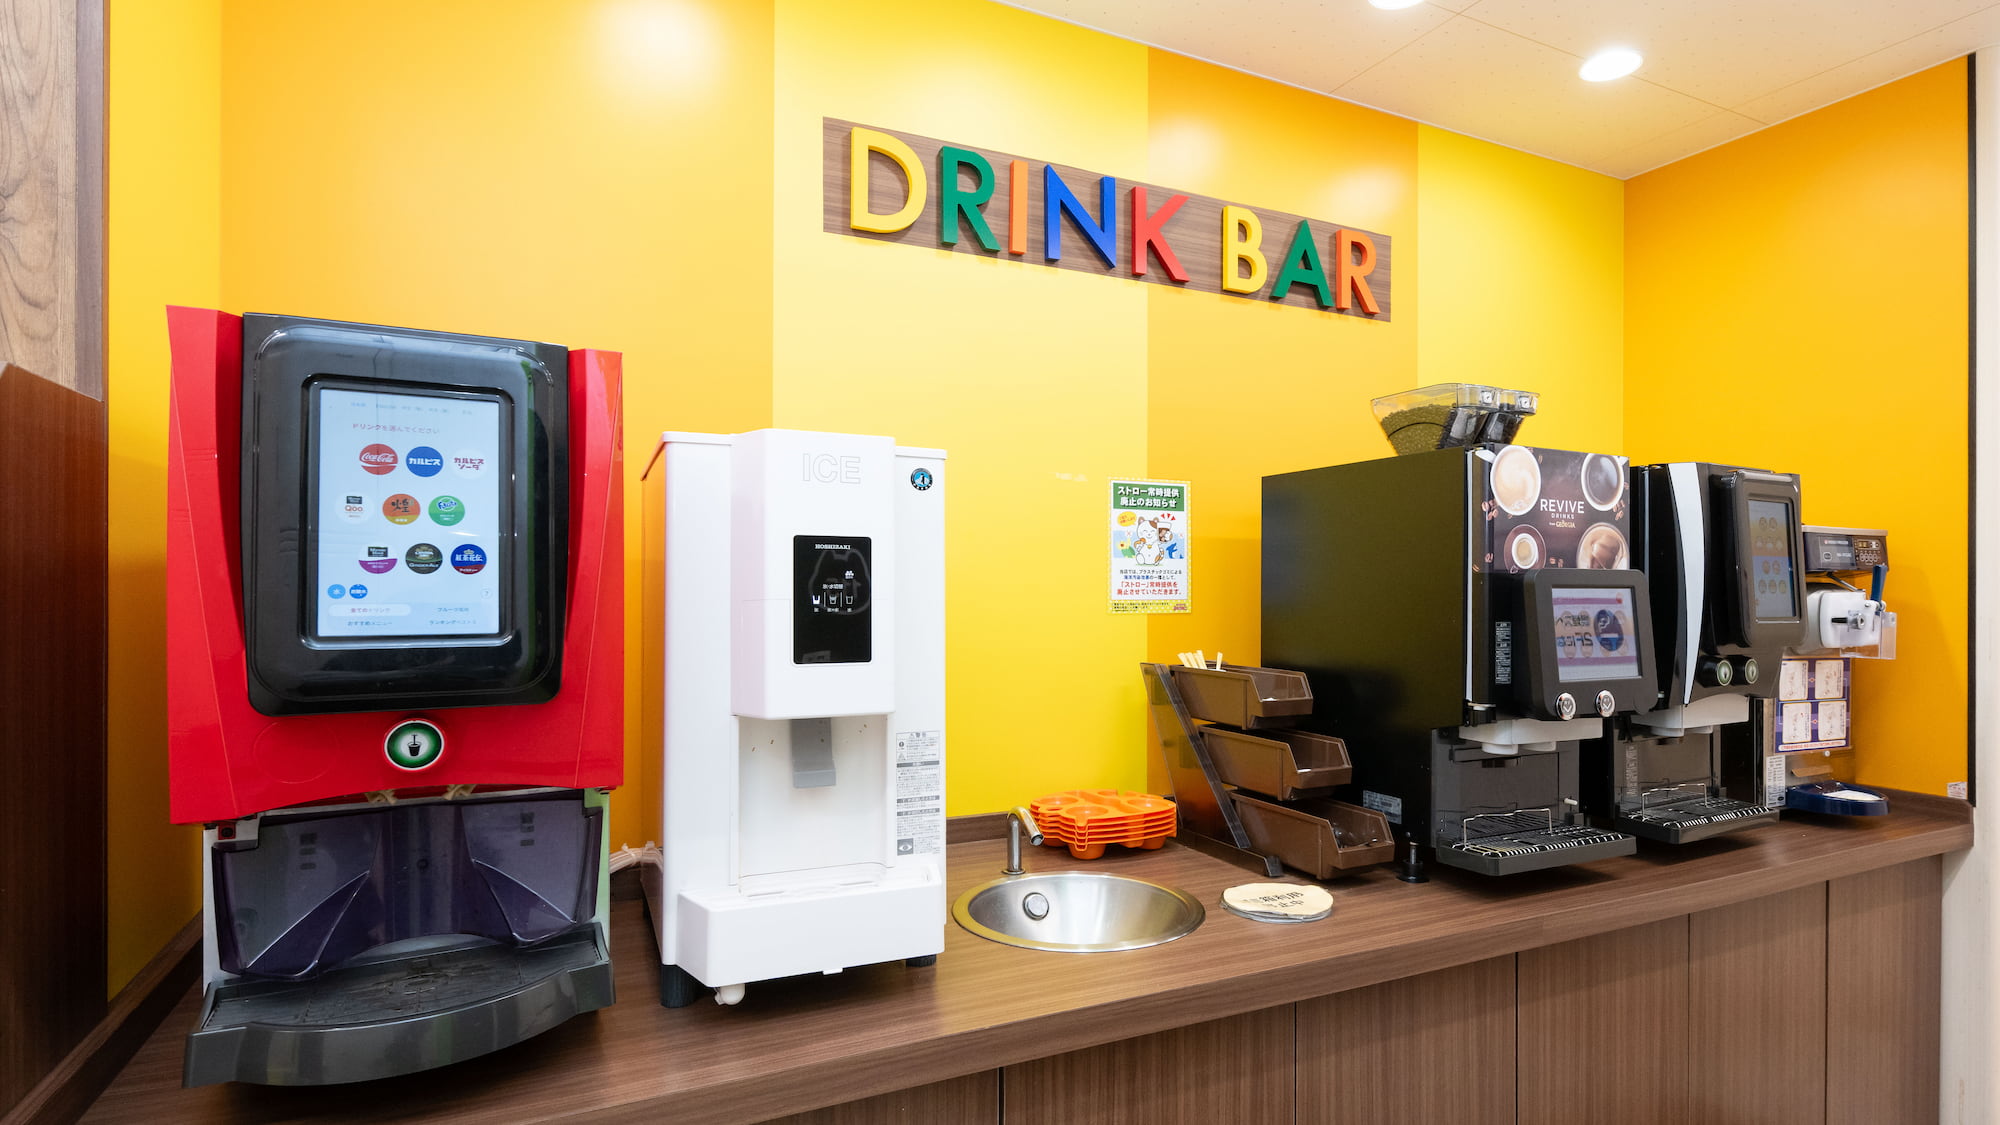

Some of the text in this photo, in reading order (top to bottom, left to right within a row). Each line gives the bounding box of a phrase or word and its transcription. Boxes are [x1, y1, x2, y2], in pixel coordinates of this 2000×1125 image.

[850, 126, 1381, 315] DRINK BAR
[408, 457, 441, 466] カルピス
[802, 453, 862, 485] ICE
[1117, 486, 1180, 498] ストロー常時提供
[1120, 496, 1177, 508] 廃止のお知らせ
[1540, 498, 1585, 514] REVIVE
